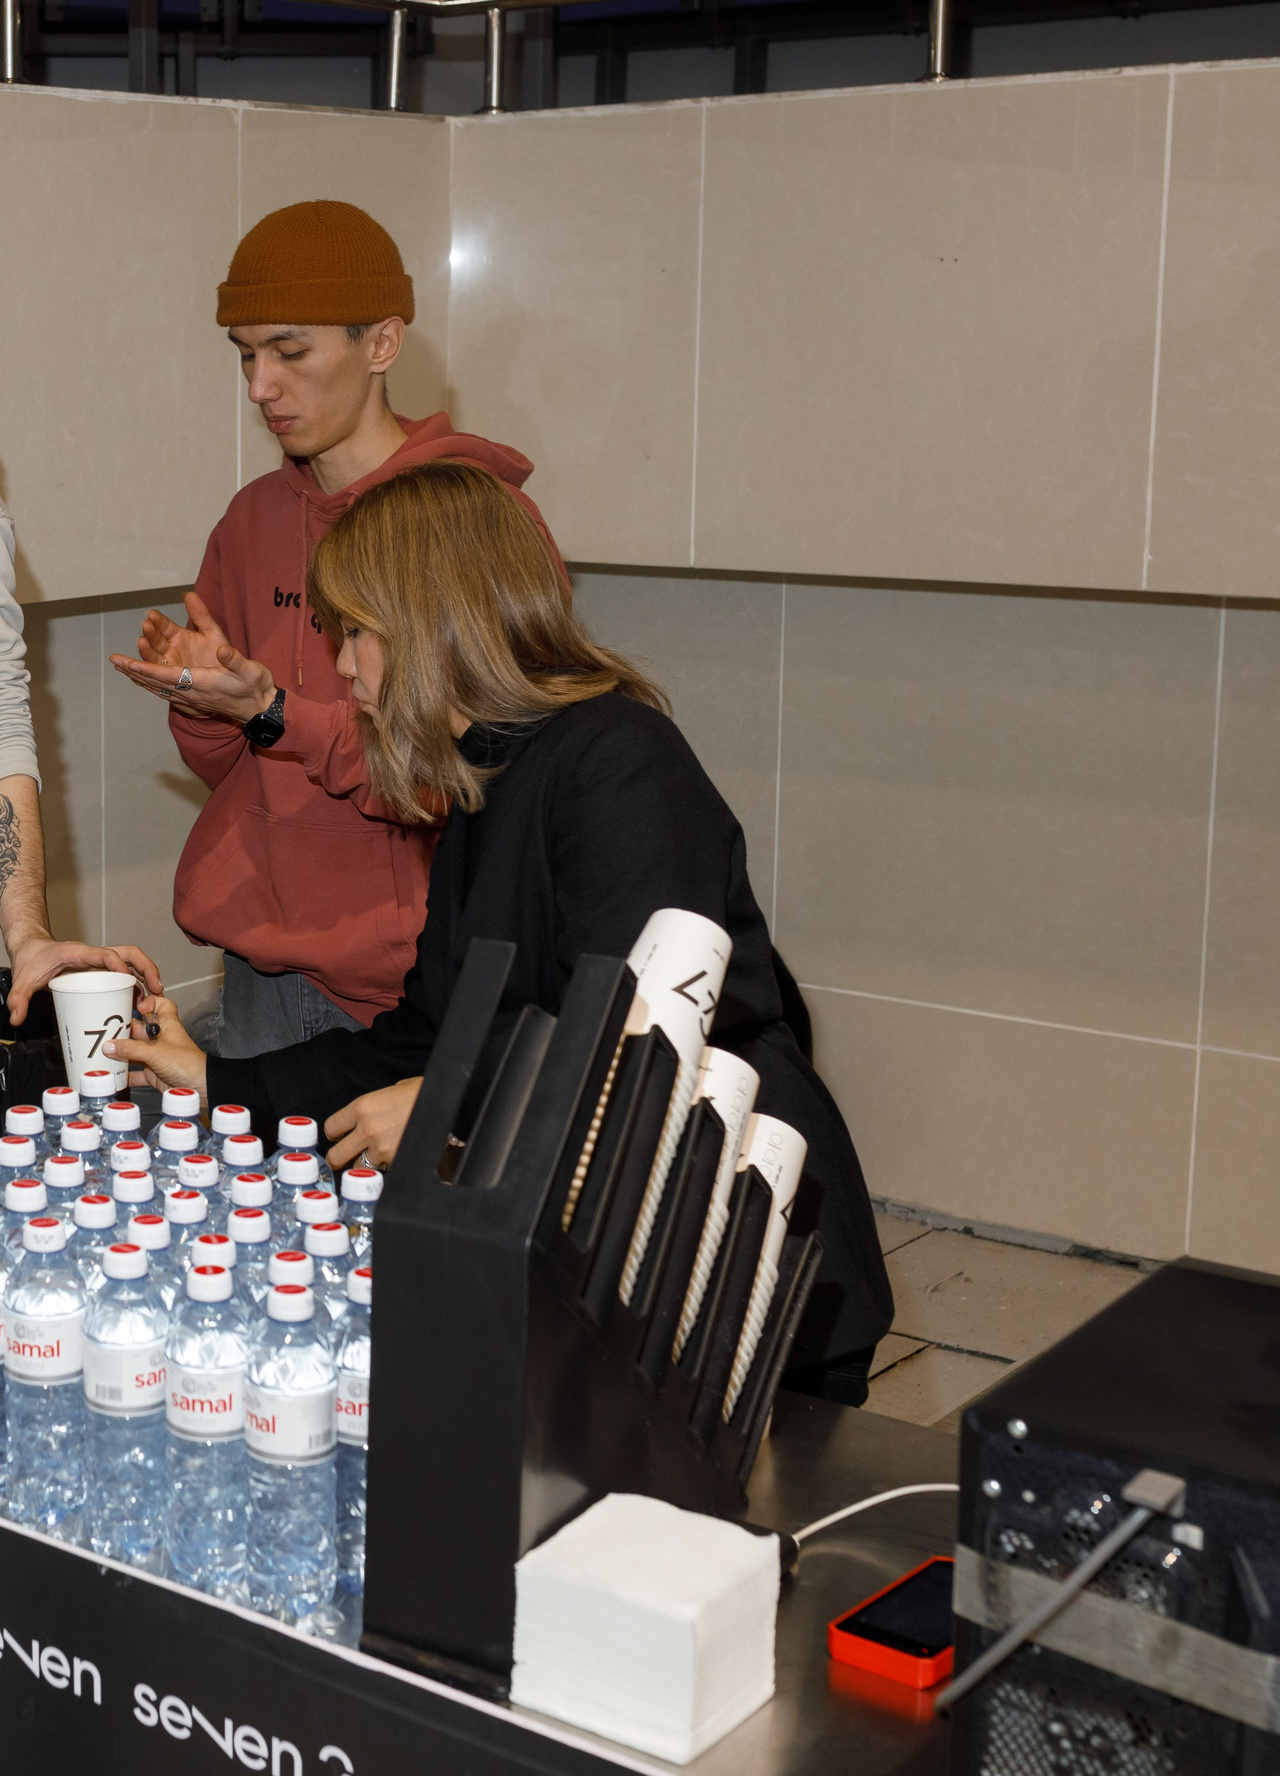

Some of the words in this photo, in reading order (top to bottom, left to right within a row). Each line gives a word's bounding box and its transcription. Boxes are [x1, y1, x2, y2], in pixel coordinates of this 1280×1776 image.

[6, 1337, 61, 1359] samal
[171, 1392, 233, 1415] samal
[133, 1682, 303, 1776] seven
